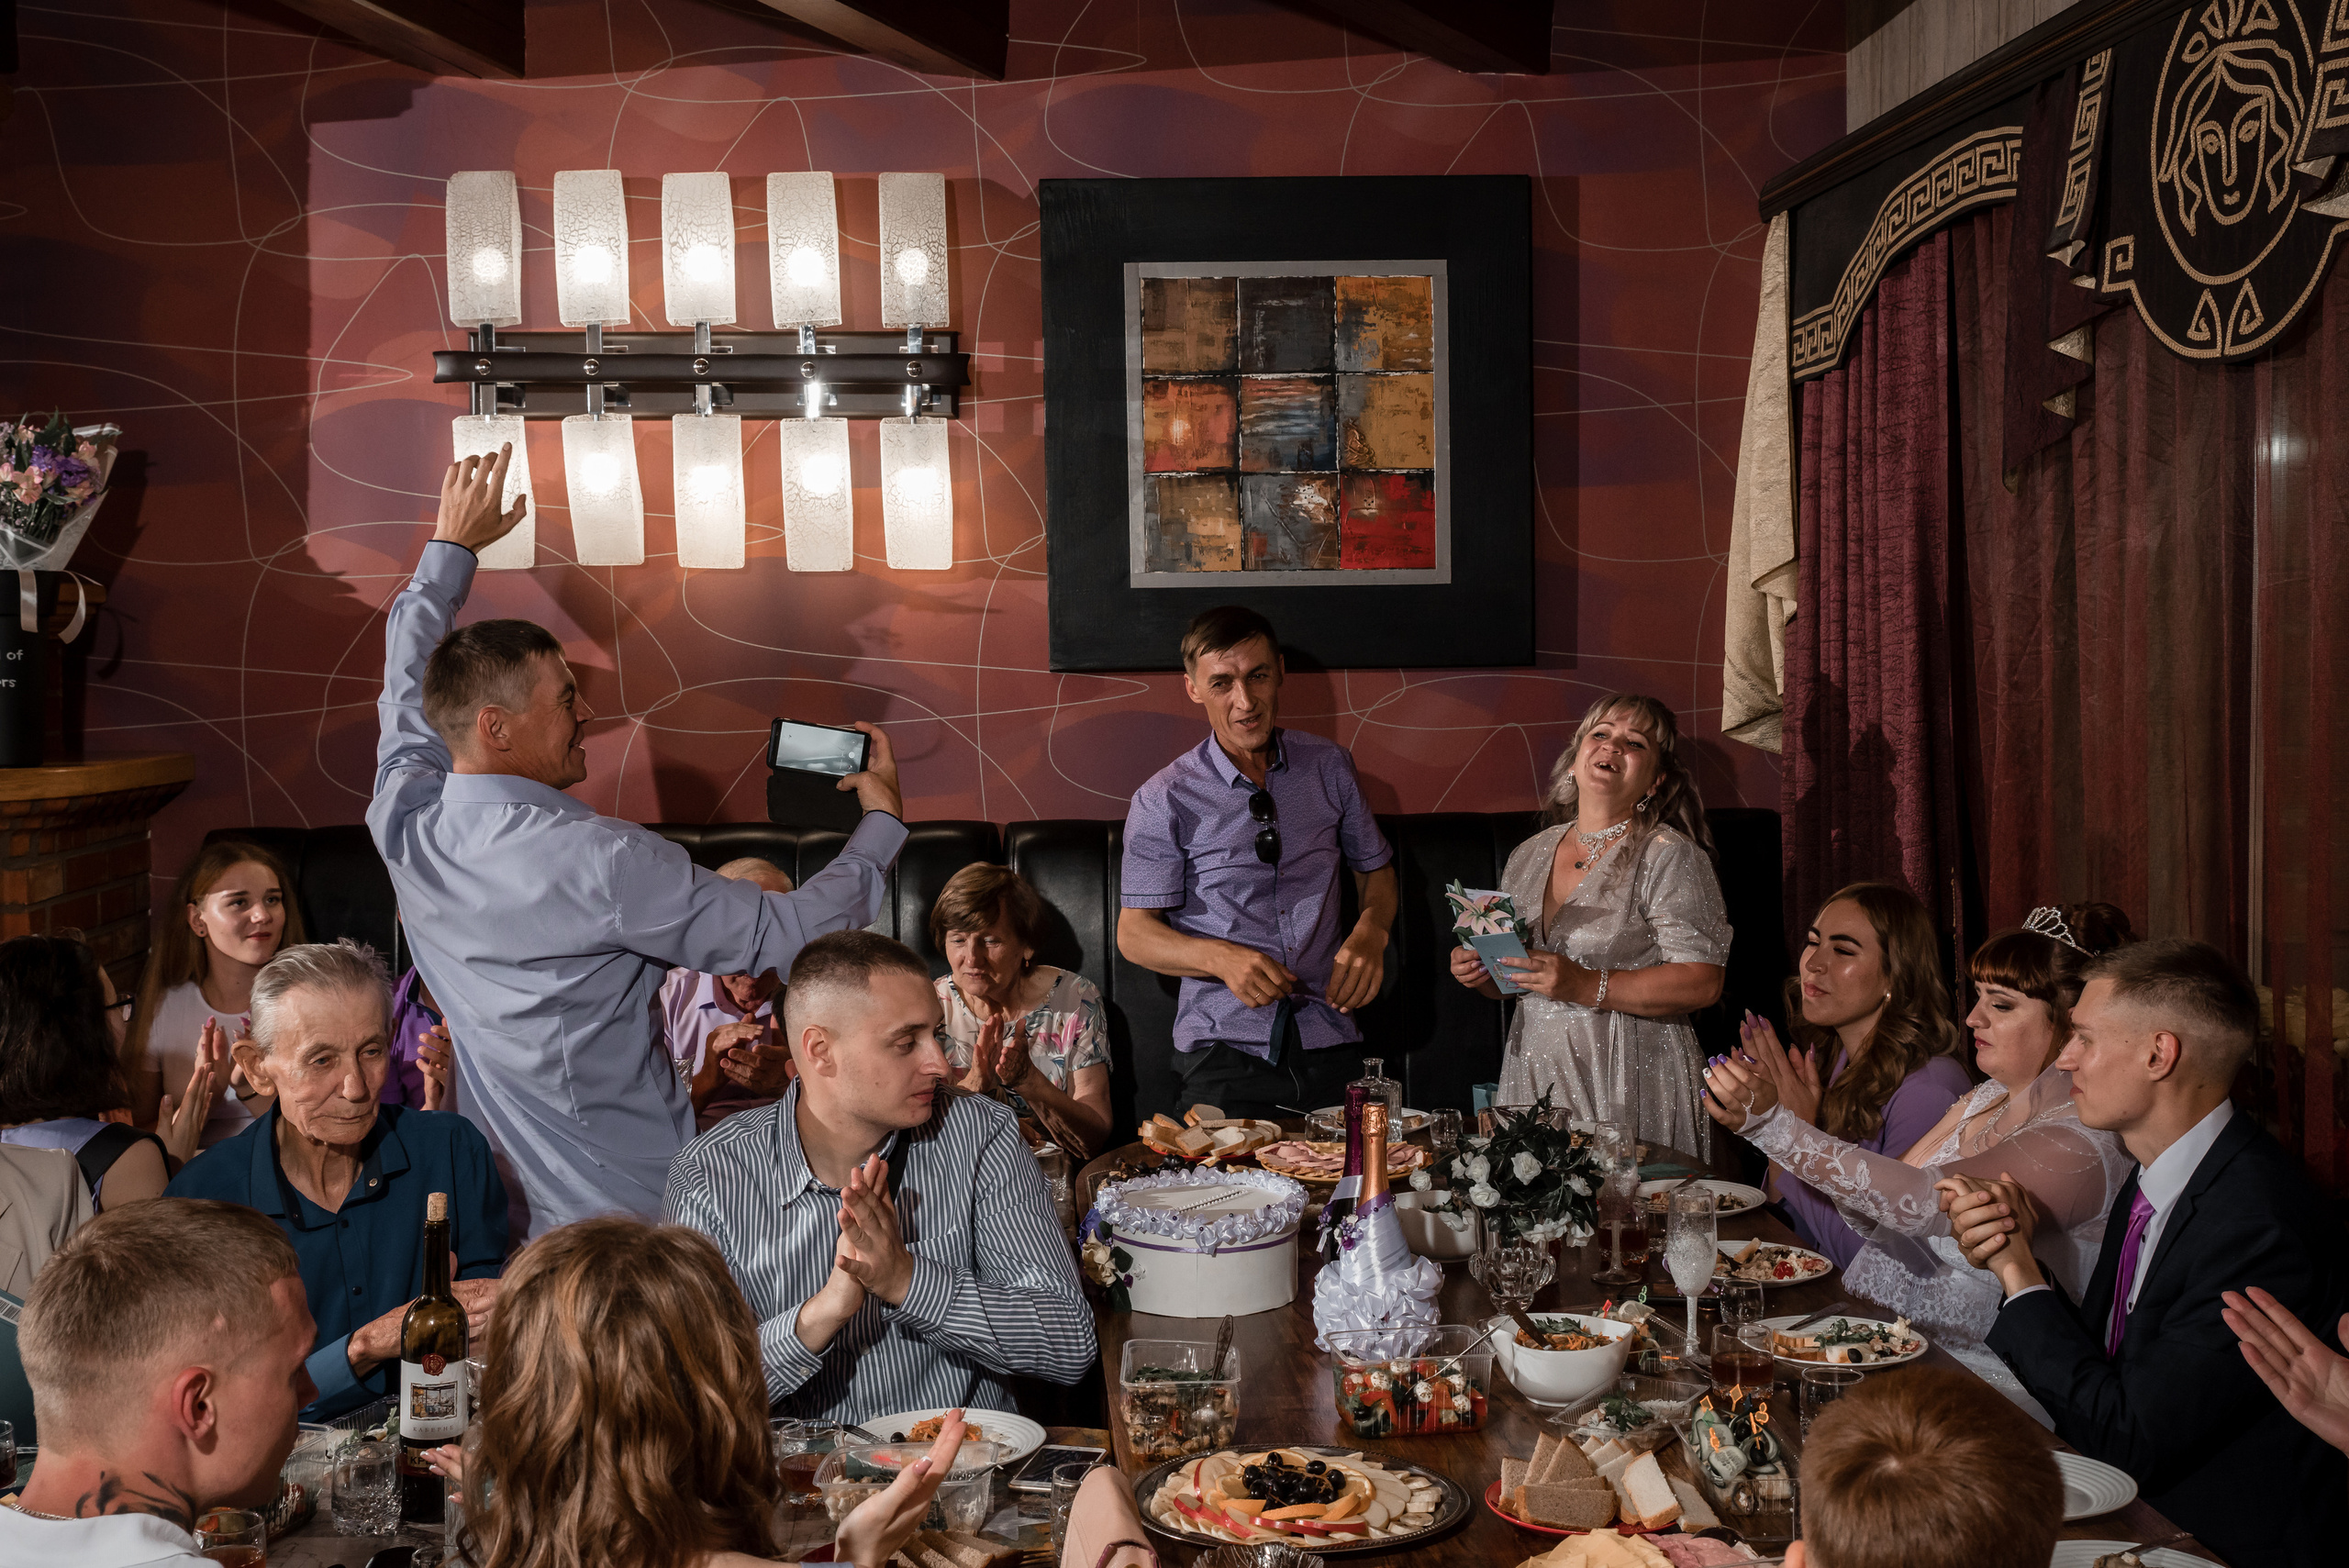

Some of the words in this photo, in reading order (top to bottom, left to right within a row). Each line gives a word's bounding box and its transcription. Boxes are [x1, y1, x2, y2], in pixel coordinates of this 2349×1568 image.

[6, 650, 24, 661] of
[0, 679, 17, 688] rs
[413, 1425, 454, 1433] КАБЕРНЕ
